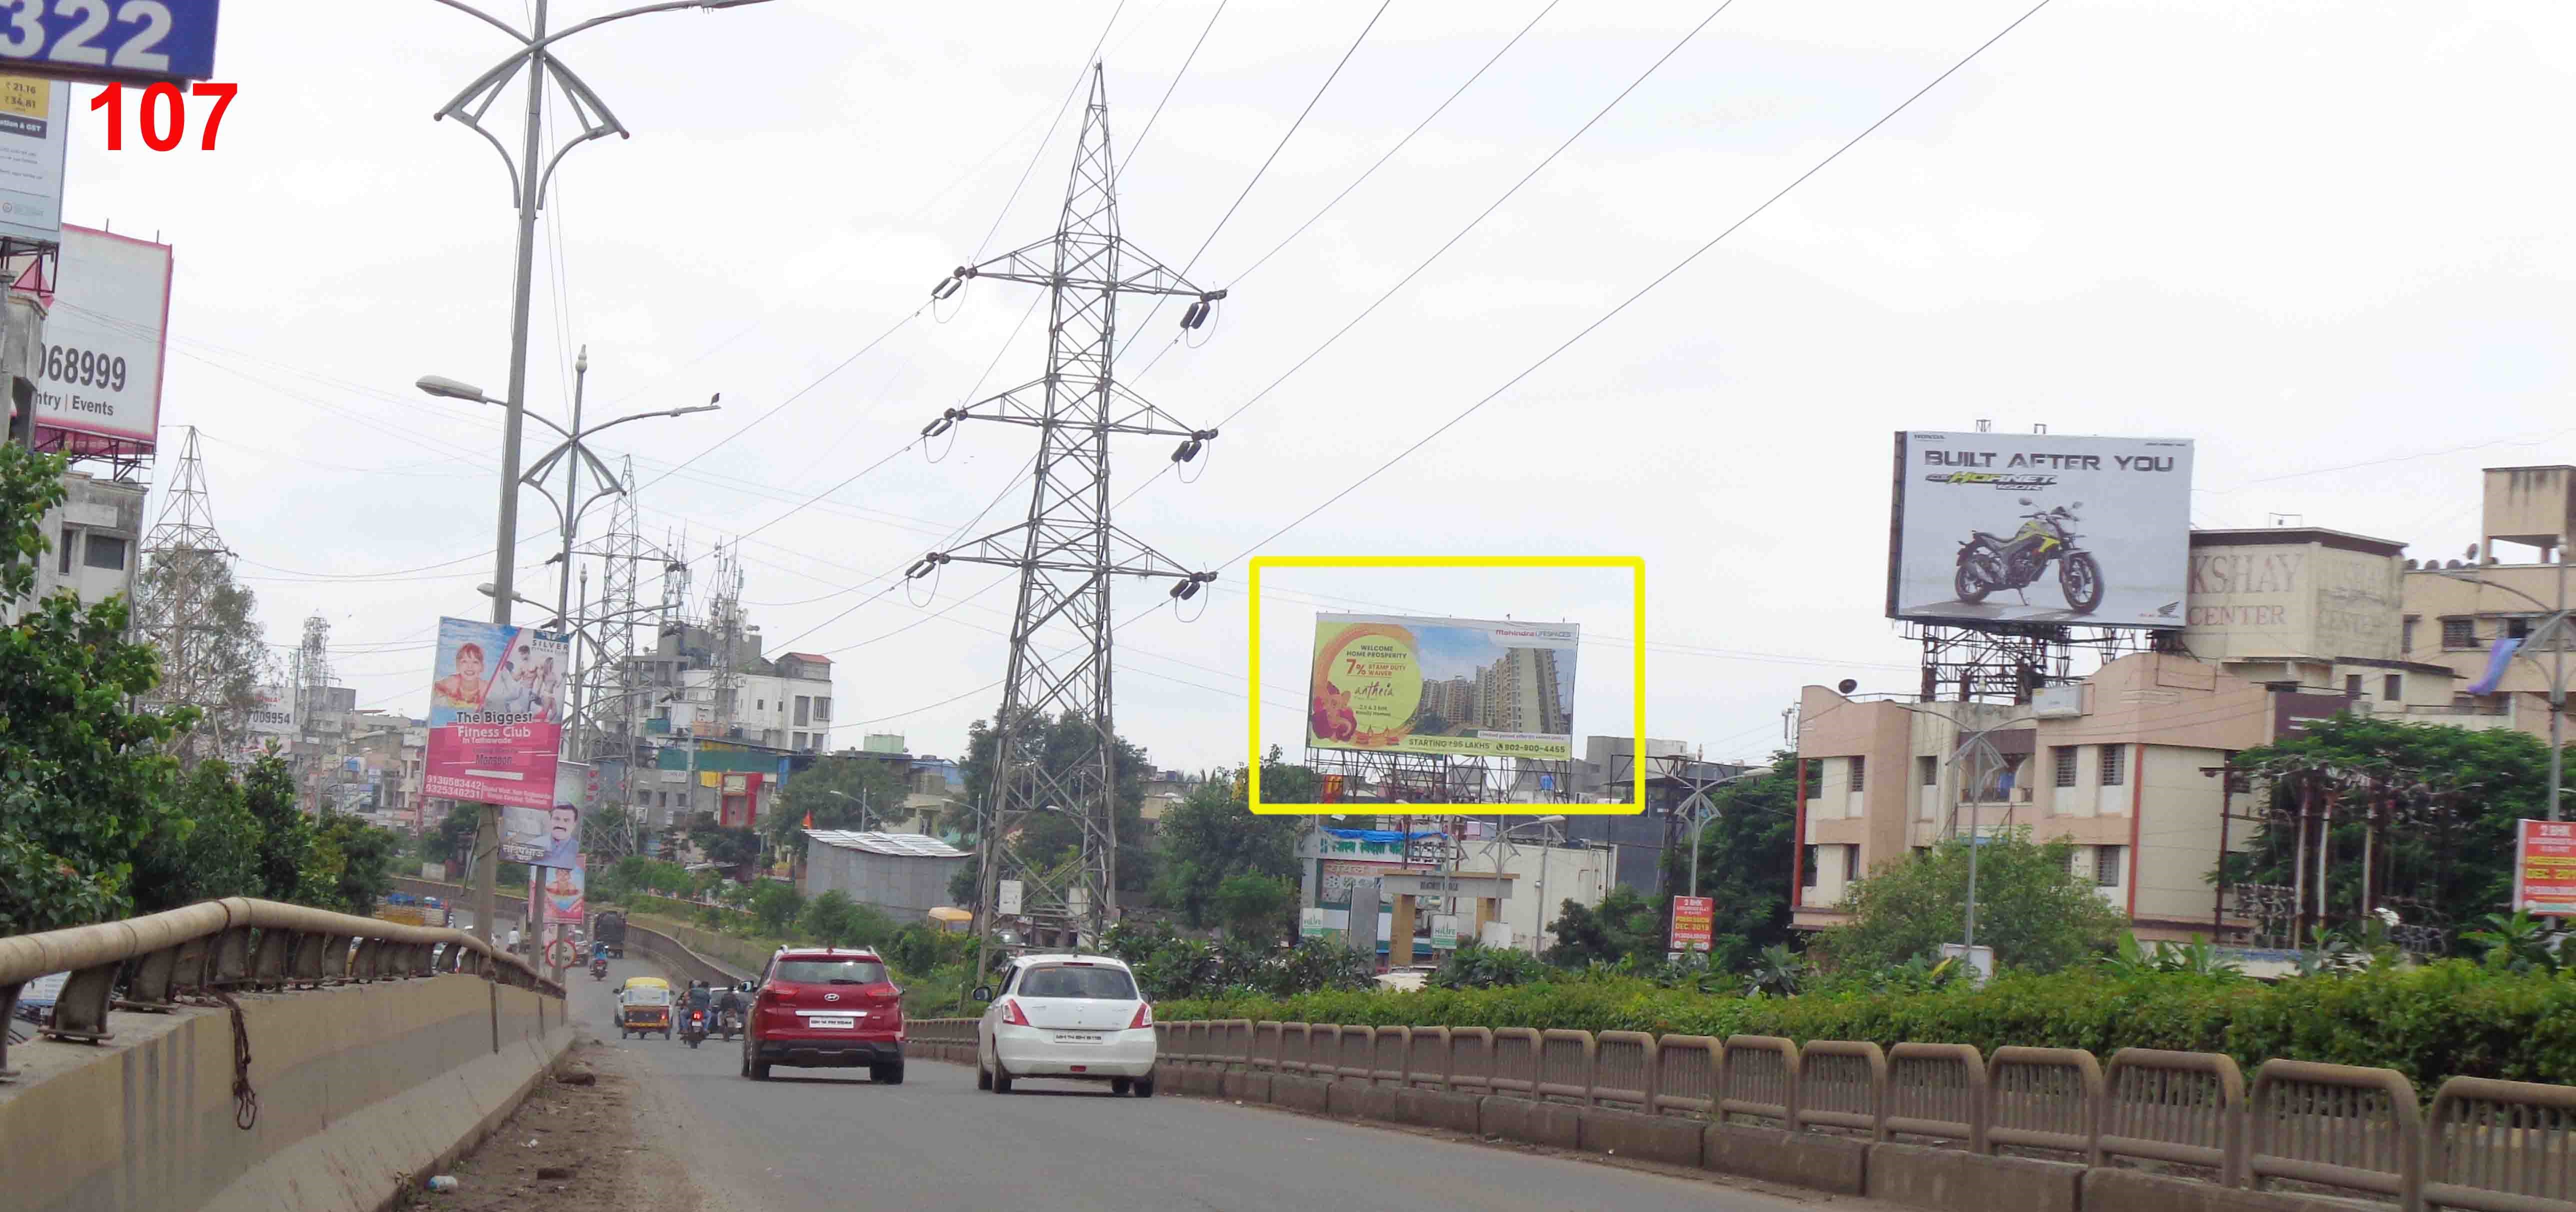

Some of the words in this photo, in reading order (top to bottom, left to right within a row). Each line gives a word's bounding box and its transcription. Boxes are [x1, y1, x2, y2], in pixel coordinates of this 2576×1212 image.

[72, 395, 114, 416] Events
[1925, 450, 1997, 468] BUILT
[2006, 452, 2102, 471] AFTER
[2114, 455, 2174, 472] YOU
[2188, 605, 2288, 626] CENTER
[1367, 651, 1408, 659] PROSPERITY
[456, 711, 481, 723] The
[484, 711, 532, 725] Biggest
[456, 725, 499, 737] Fitness
[502, 725, 531, 737] Club
[1408, 739, 1448, 748] STARTING
